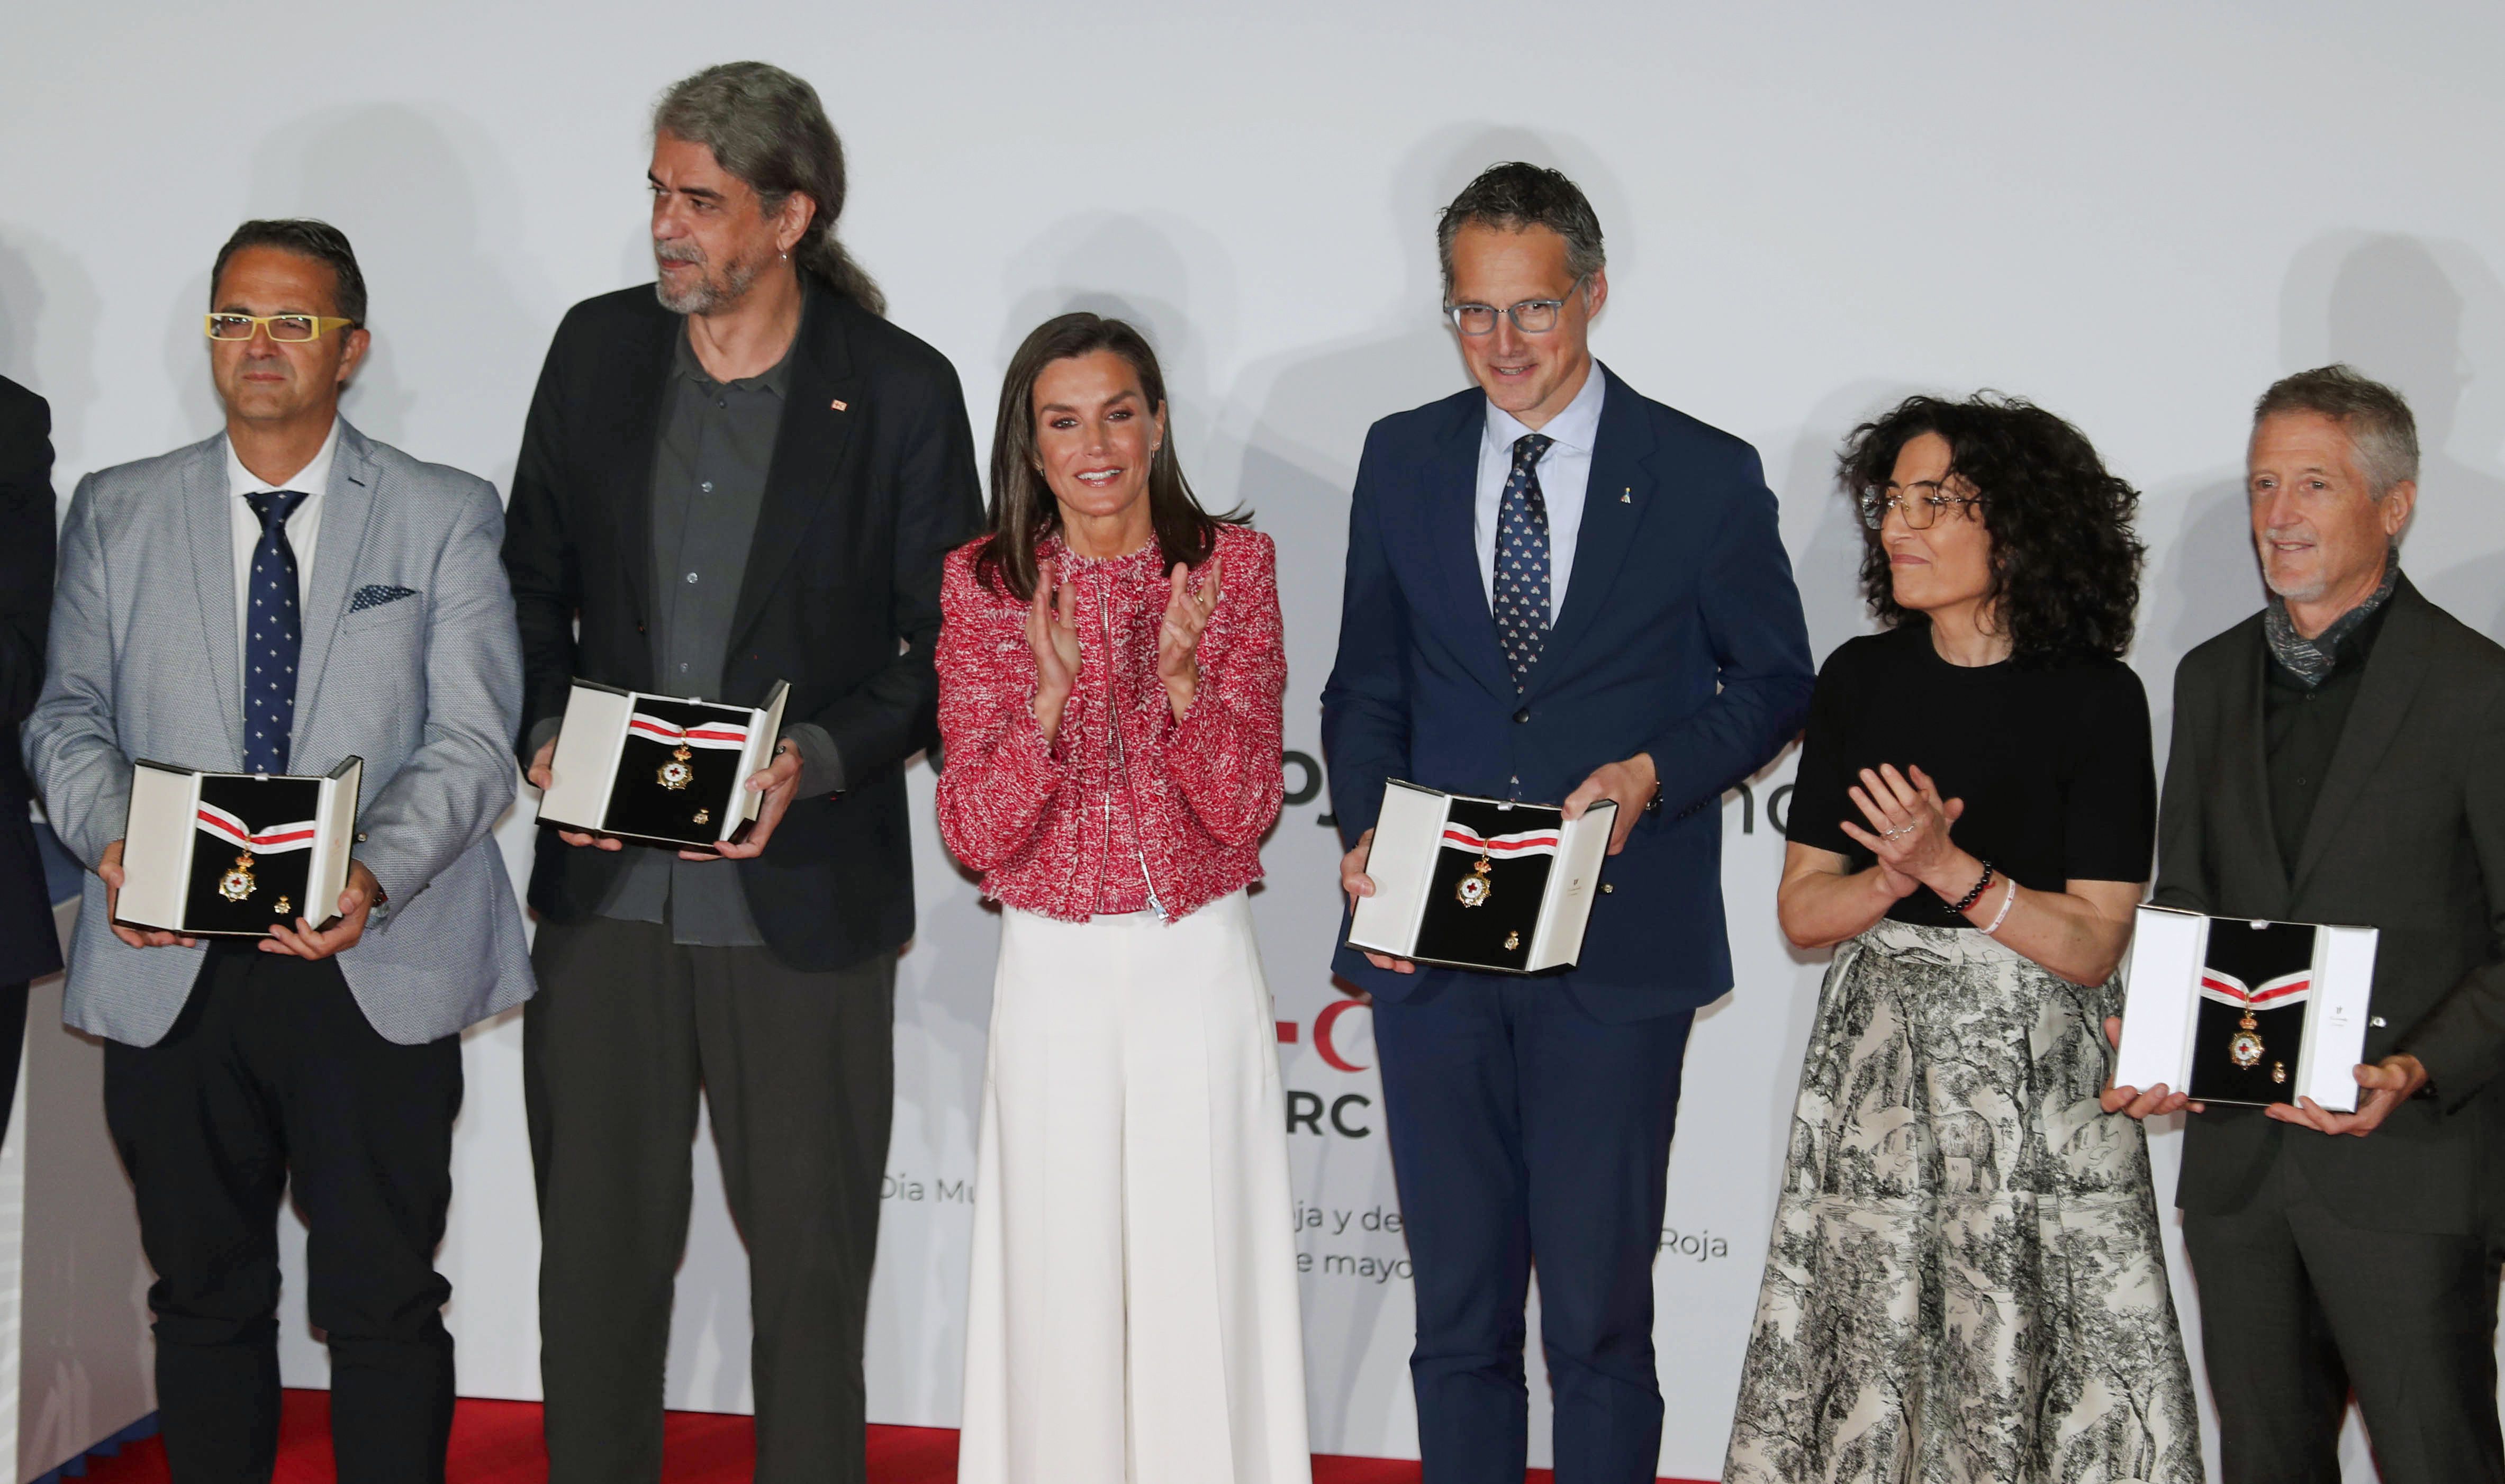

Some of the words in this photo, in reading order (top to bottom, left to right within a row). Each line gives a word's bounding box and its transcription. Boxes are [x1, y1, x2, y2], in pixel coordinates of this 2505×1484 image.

[1332, 1210, 1352, 1235] y
[1362, 1205, 1403, 1233] de
[1658, 1227, 1728, 1262] Roja
[1325, 1255, 1414, 1284] mayo
